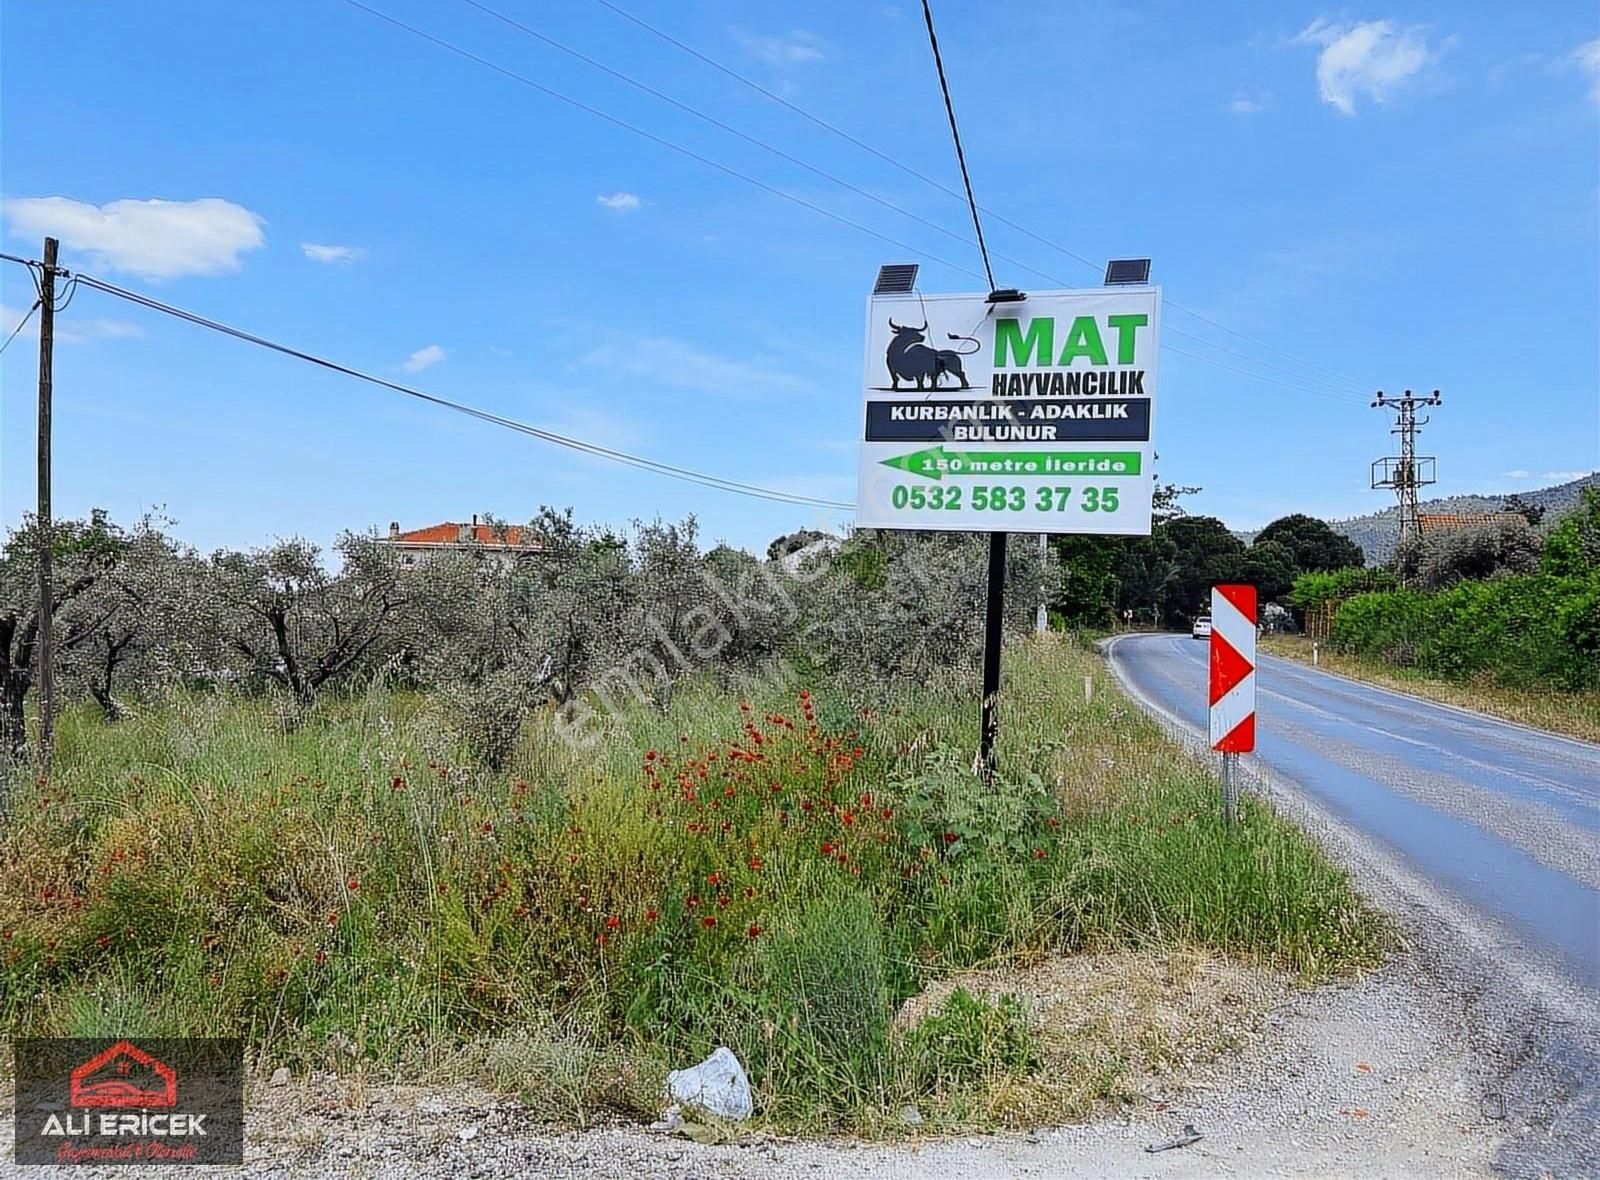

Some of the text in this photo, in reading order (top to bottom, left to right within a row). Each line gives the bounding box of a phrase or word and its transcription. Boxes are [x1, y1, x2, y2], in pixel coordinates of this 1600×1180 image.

[993, 313, 1148, 368] MAT
[992, 370, 1145, 396] HAYVANCILIK
[890, 405, 1012, 420] KURBANLIK
[1030, 403, 1129, 419] ADAKLIK
[954, 425, 1057, 440] BULUNUR
[922, 459, 961, 472] 150
[970, 459, 1038, 472] metre
[891, 485, 1119, 512] 0532 583 37 35
